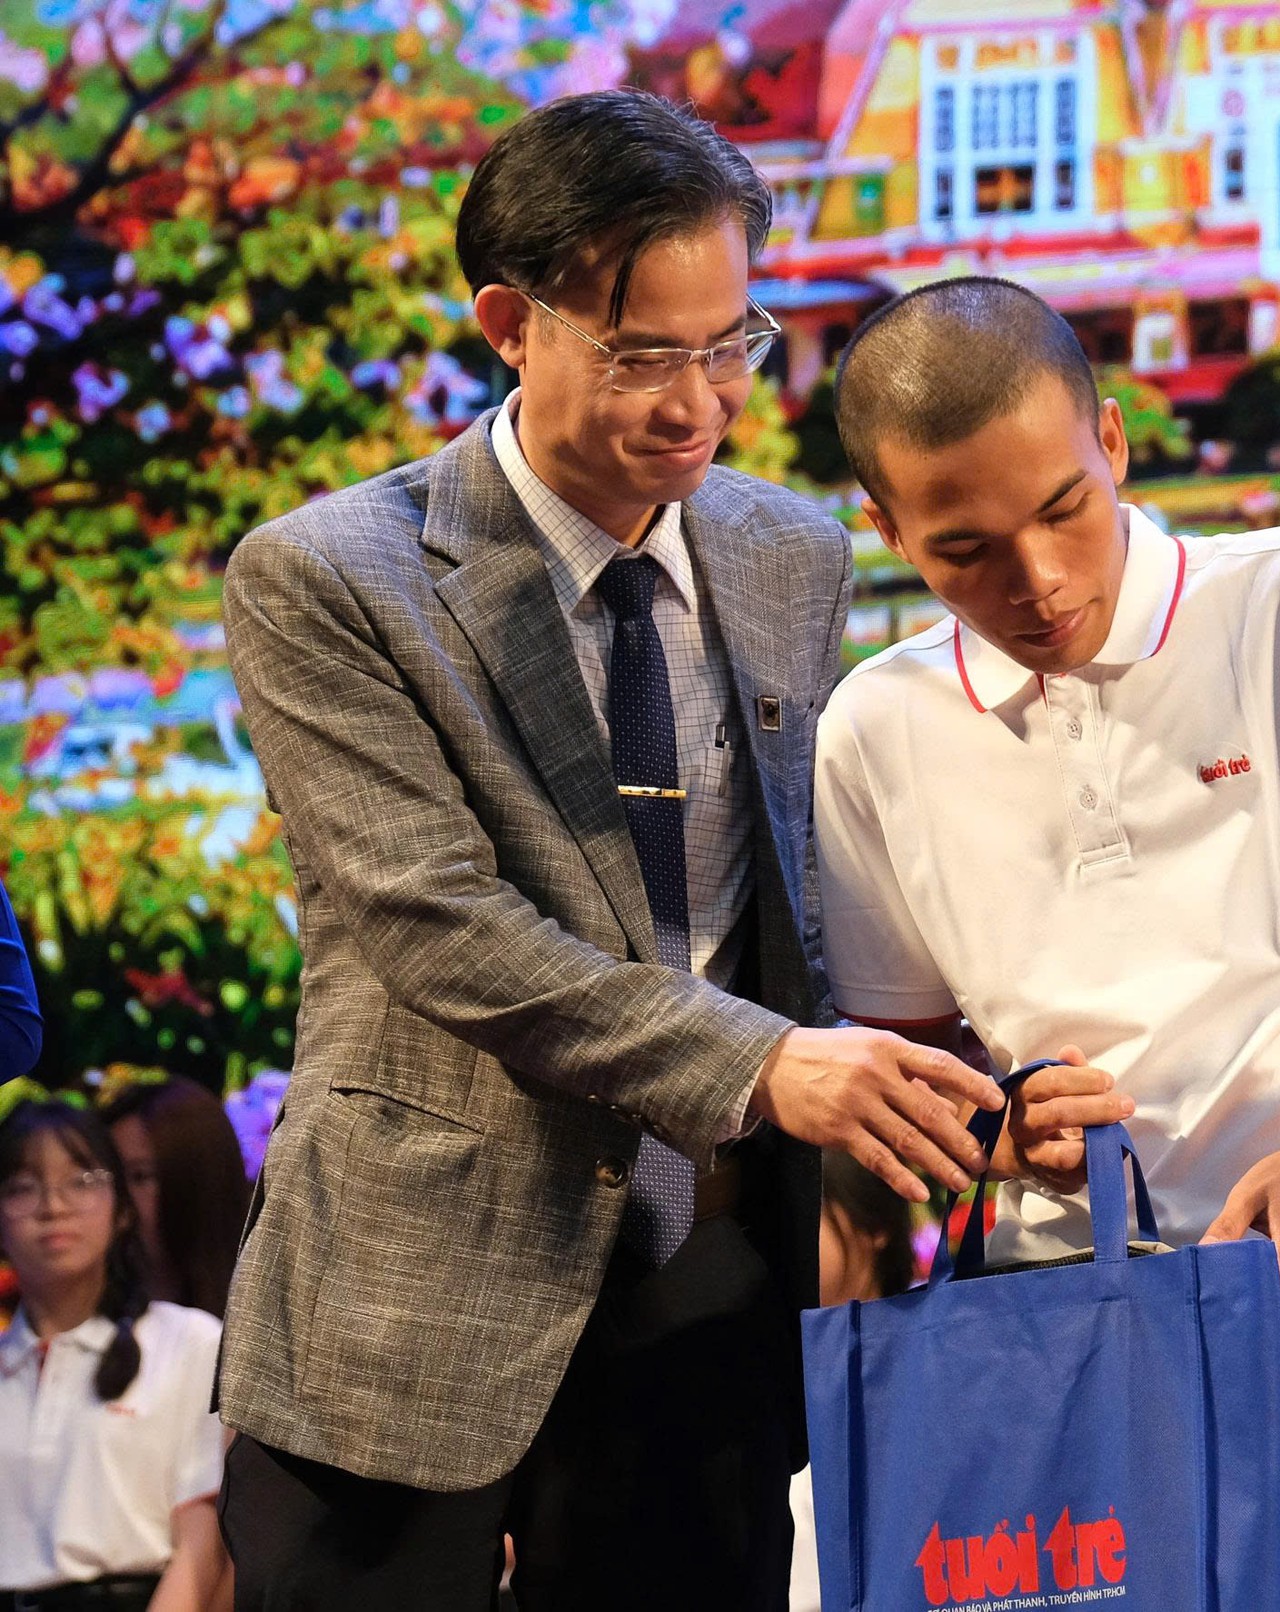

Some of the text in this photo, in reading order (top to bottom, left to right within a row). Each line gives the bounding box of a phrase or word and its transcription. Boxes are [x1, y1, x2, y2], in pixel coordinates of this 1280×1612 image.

[914, 1504, 1127, 1606] tuổi trẻ
[992, 1598, 1014, 1611] PHÁT
[1013, 1596, 1048, 1609] THANH,
[1048, 1589, 1083, 1605] TRUYỀN
[1083, 1588, 1103, 1602] HÌNH
